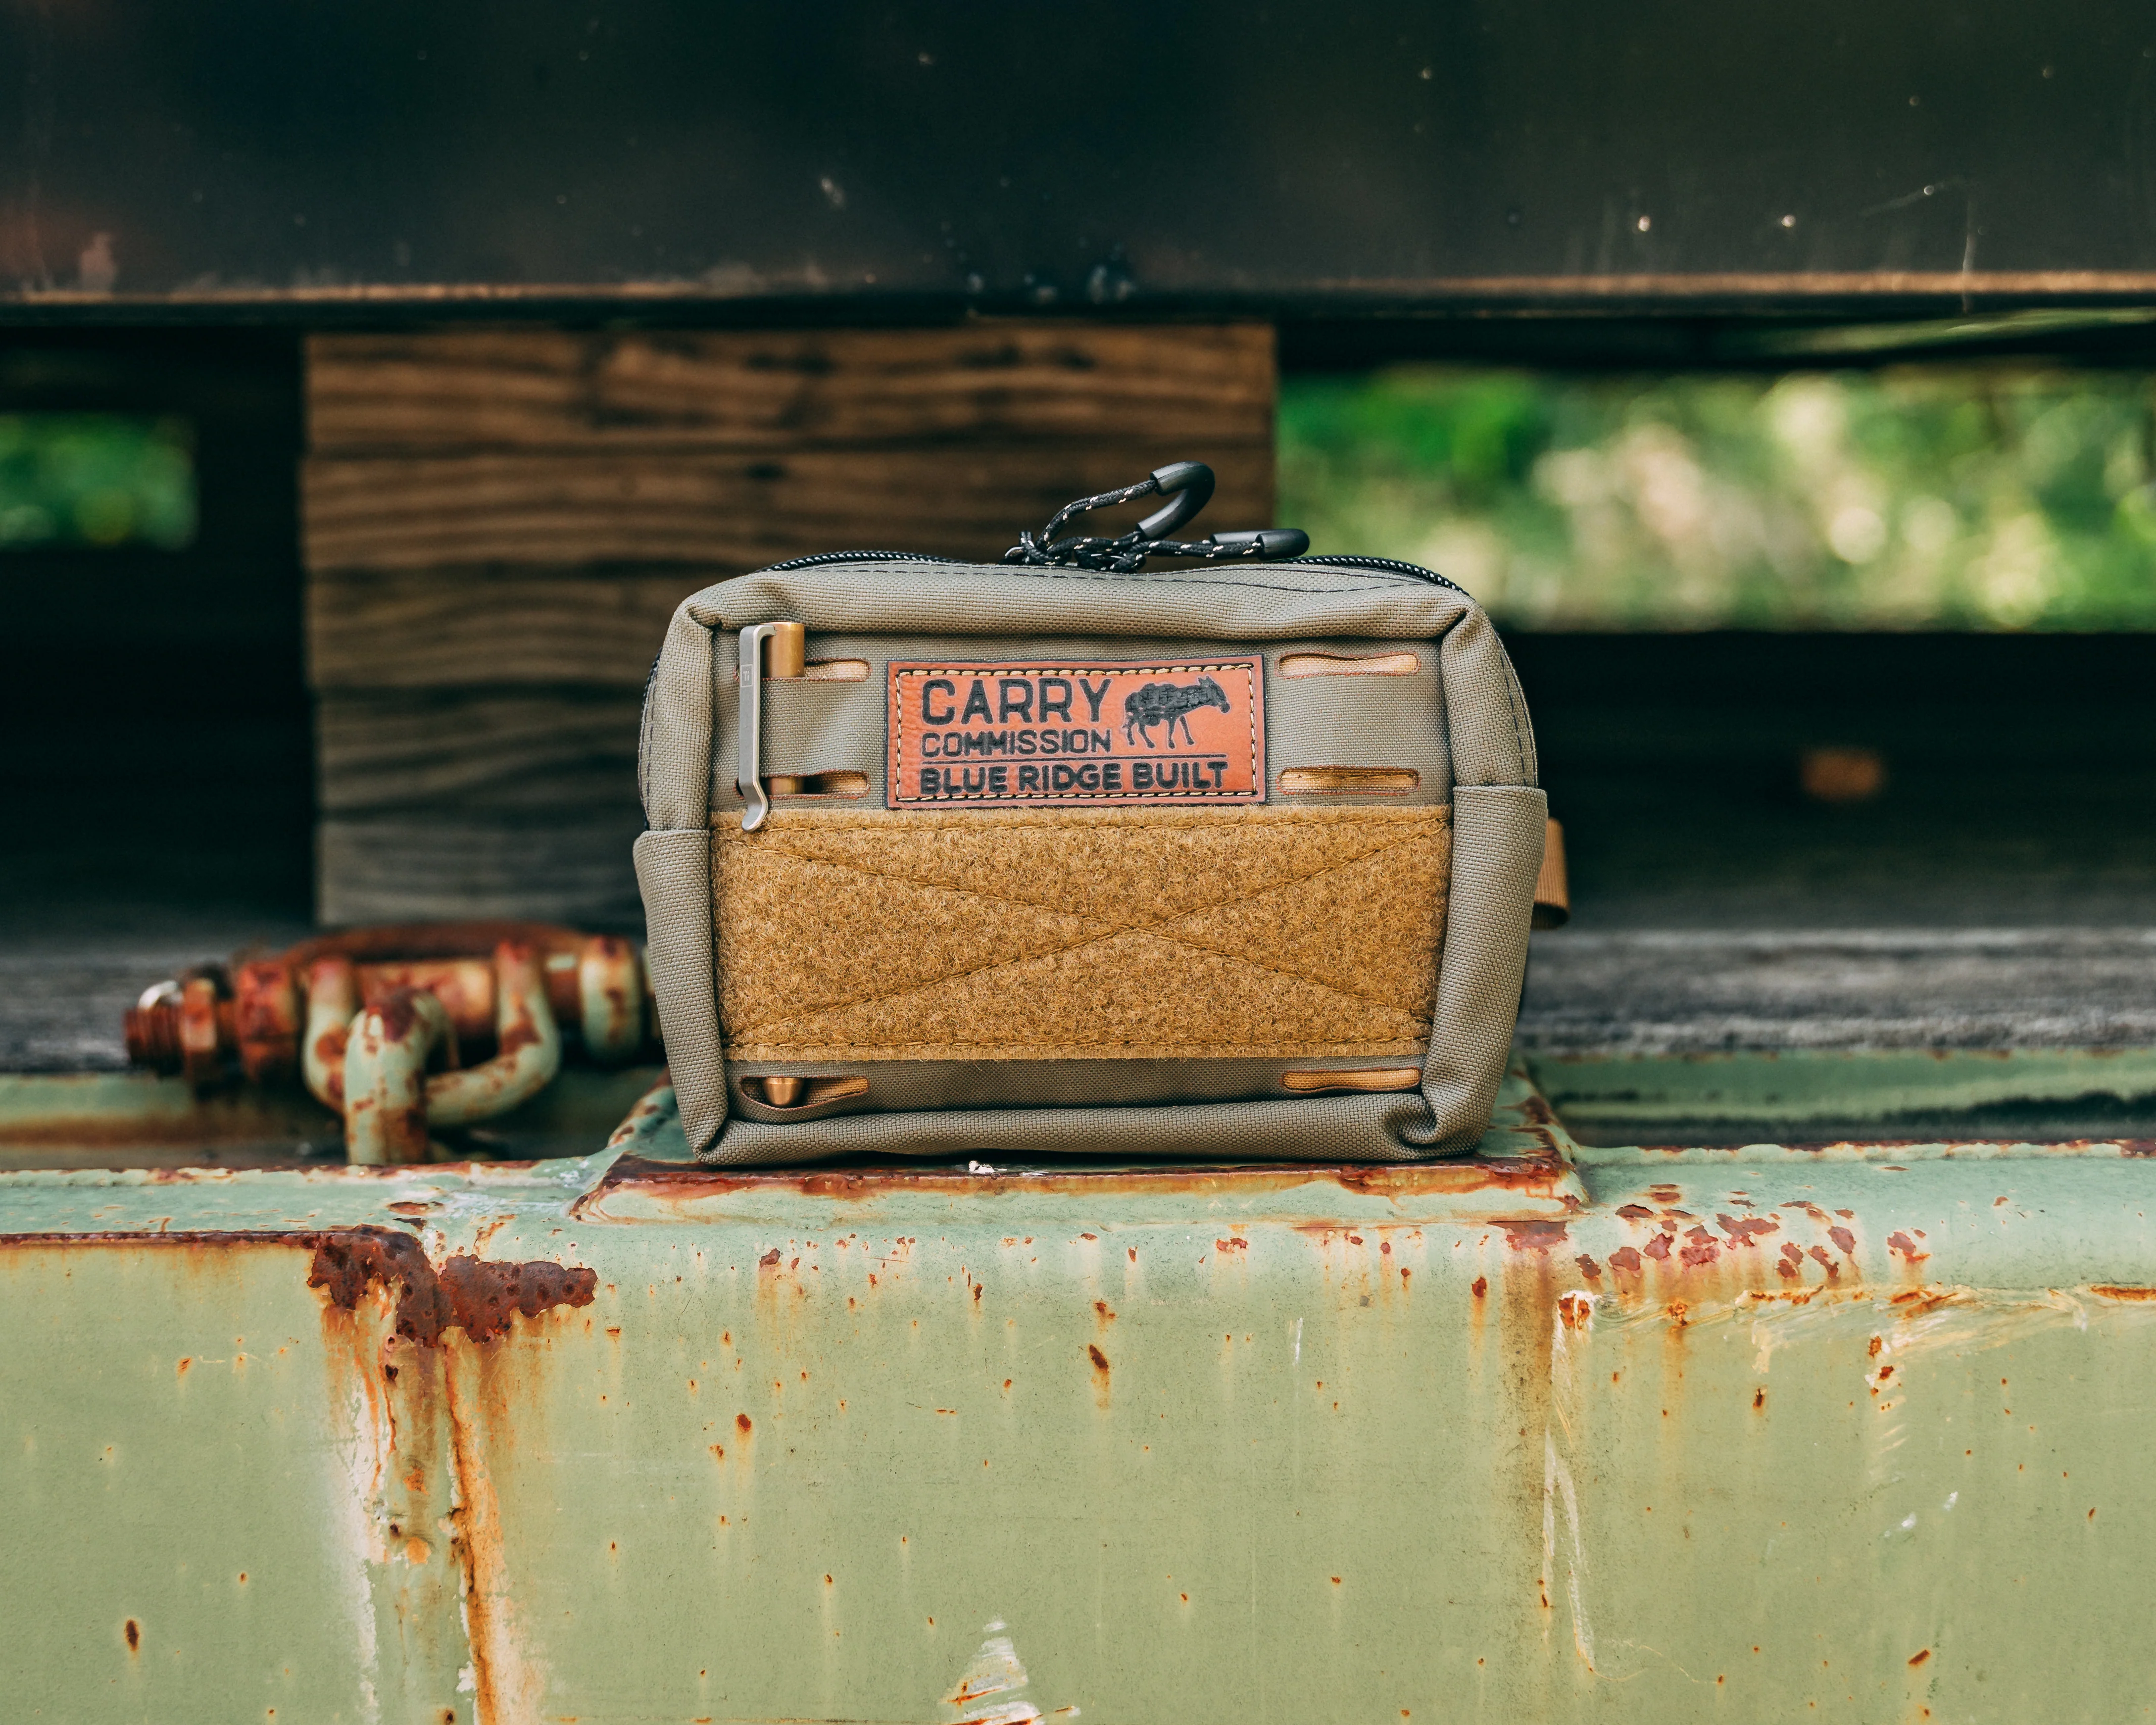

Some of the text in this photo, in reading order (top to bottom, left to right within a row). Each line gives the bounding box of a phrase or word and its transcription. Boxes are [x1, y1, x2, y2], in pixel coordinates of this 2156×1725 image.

[743, 671, 750, 682] Ti
[921, 678, 1113, 725] CARRY
[921, 729, 1111, 757] COMMISSION
[920, 761, 1227, 793] BLUE RIDGE BUILT
